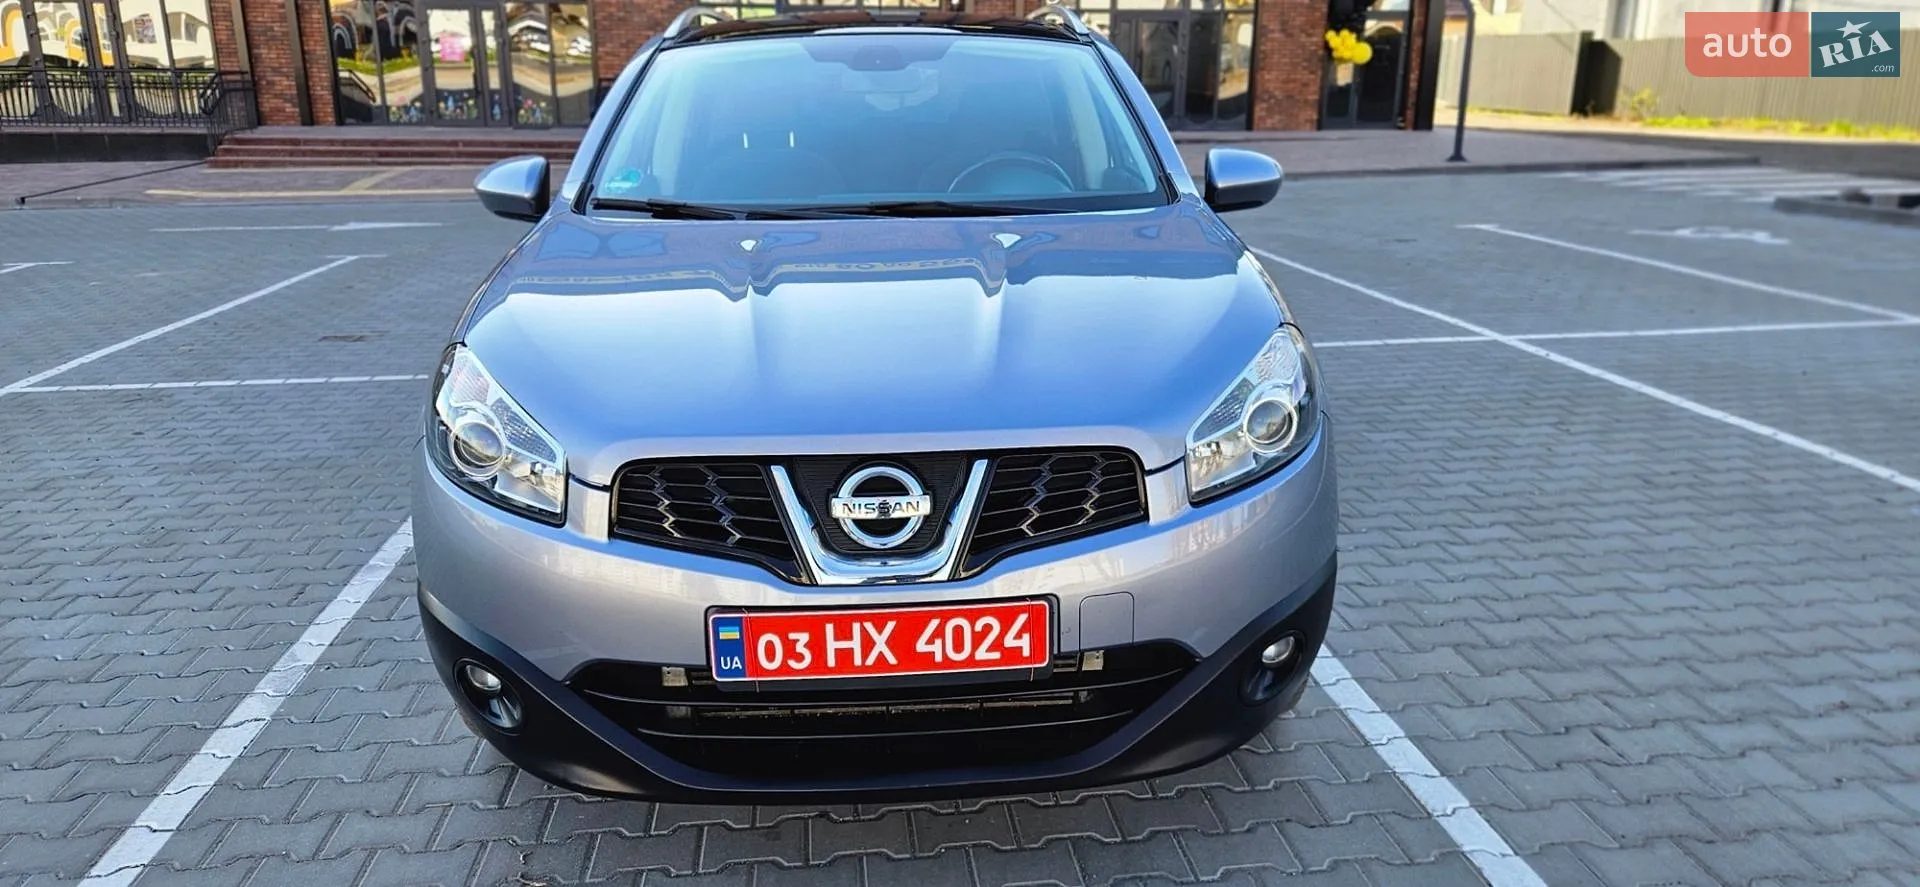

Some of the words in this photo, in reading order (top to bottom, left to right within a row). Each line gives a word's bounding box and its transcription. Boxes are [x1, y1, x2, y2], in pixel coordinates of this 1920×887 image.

[842, 500, 920, 515] NISSAN
[757, 632, 812, 671] 03
[825, 620, 899, 668] HX
[915, 613, 1031, 663] 4024
[720, 655, 743, 670] UA
